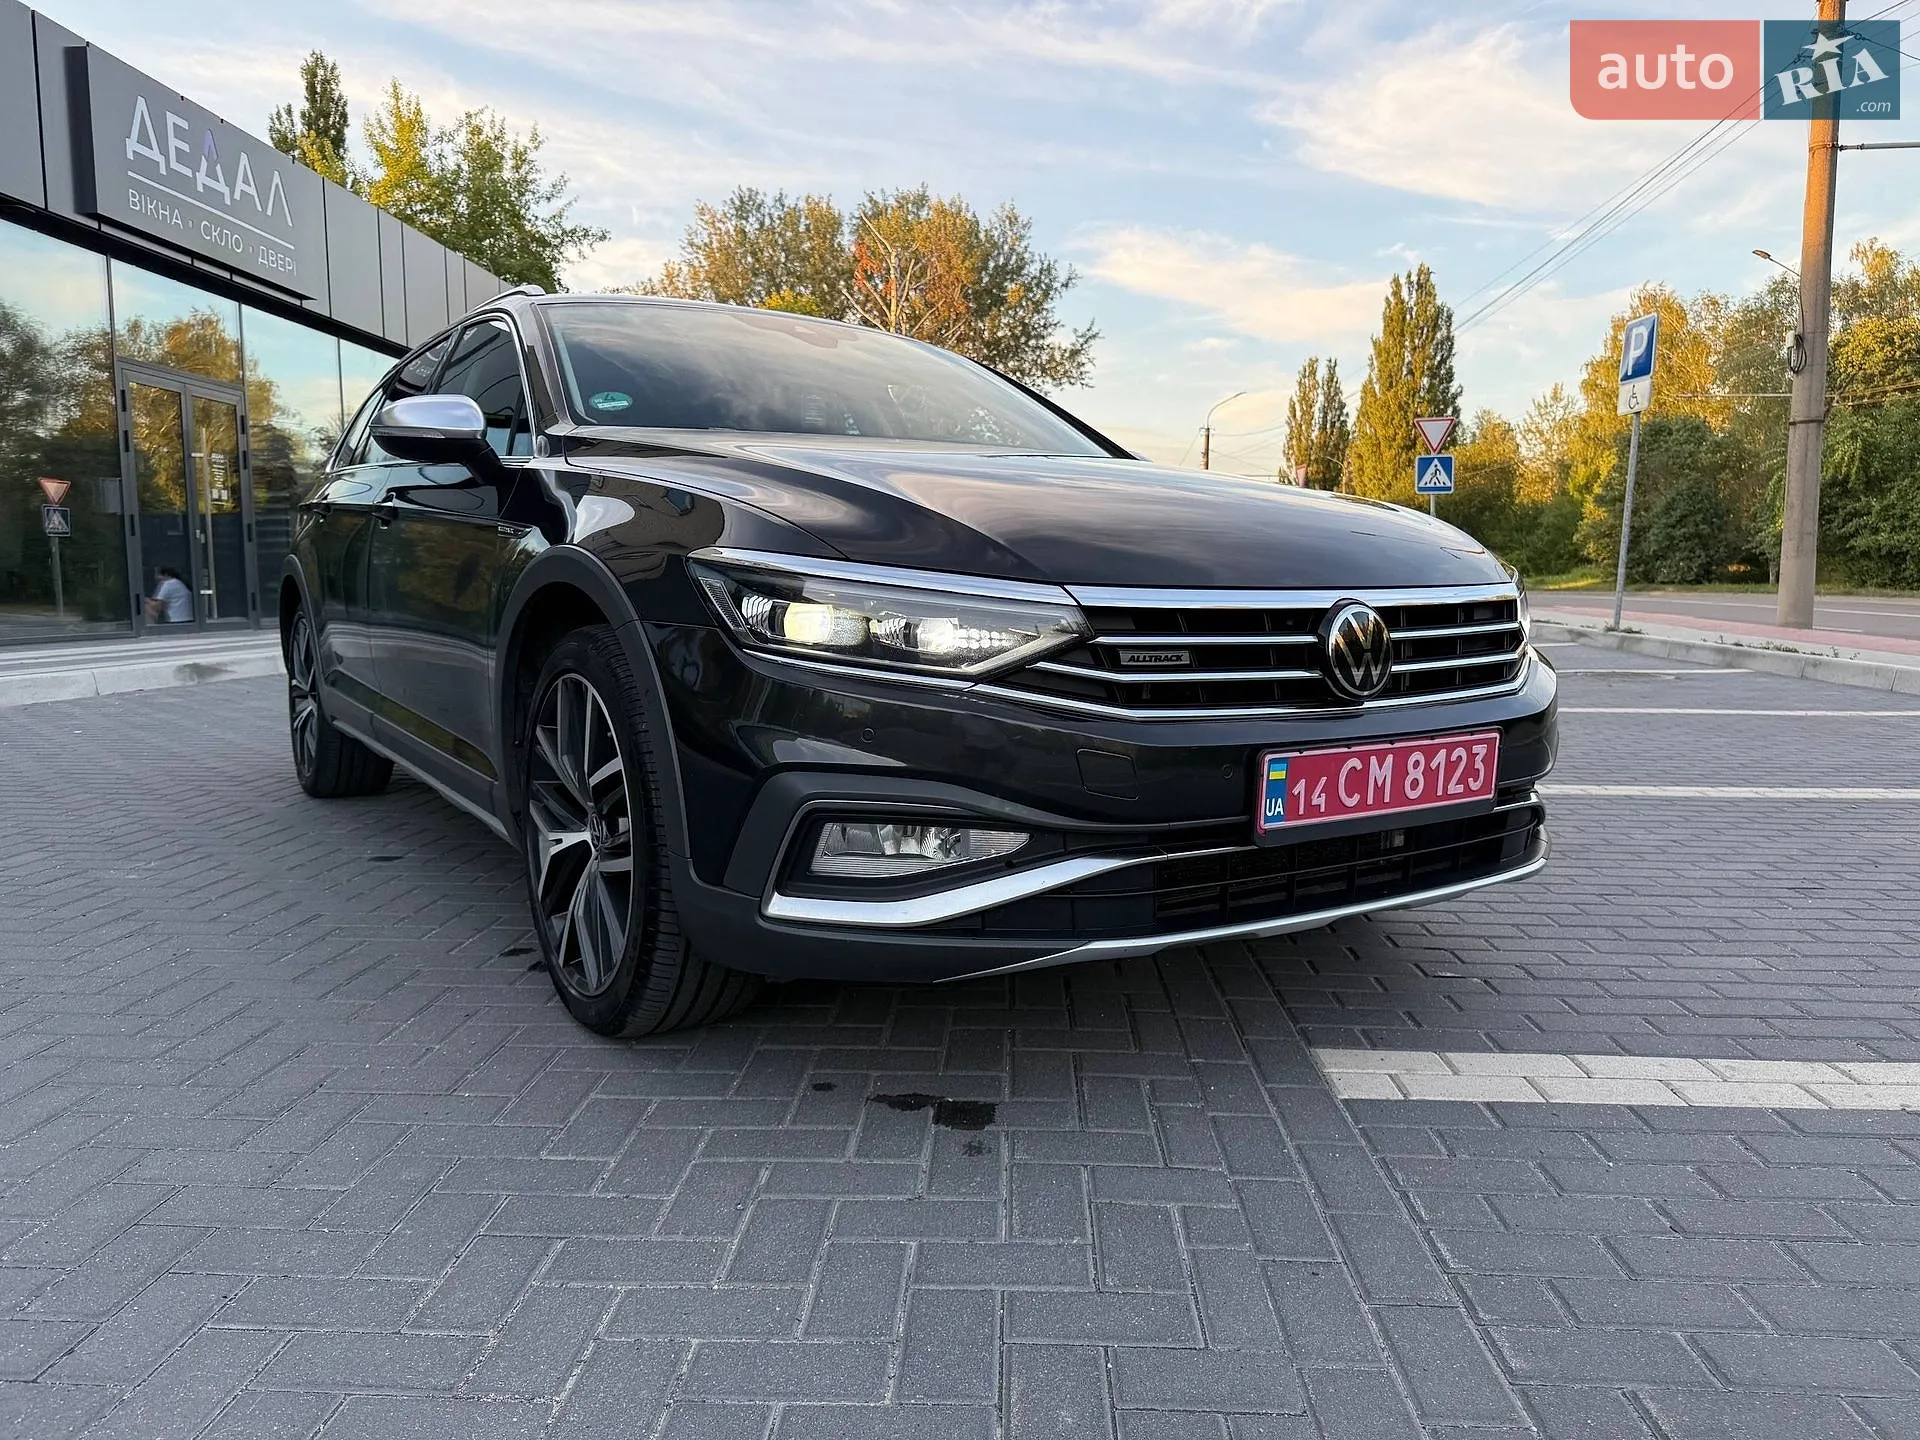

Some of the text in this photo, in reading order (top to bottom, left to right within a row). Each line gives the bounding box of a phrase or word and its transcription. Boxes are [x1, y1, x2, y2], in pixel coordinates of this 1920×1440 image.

[126, 95, 293, 228] ДЕДАЛ
[128, 188, 297, 277] ВІКНА СКЛО ДВЕРІ
[1627, 325, 1649, 376] P
[1127, 653, 1184, 664] ALLTRACK
[1265, 797, 1285, 817] UA
[1291, 744, 1489, 815] 14 CM 8123
